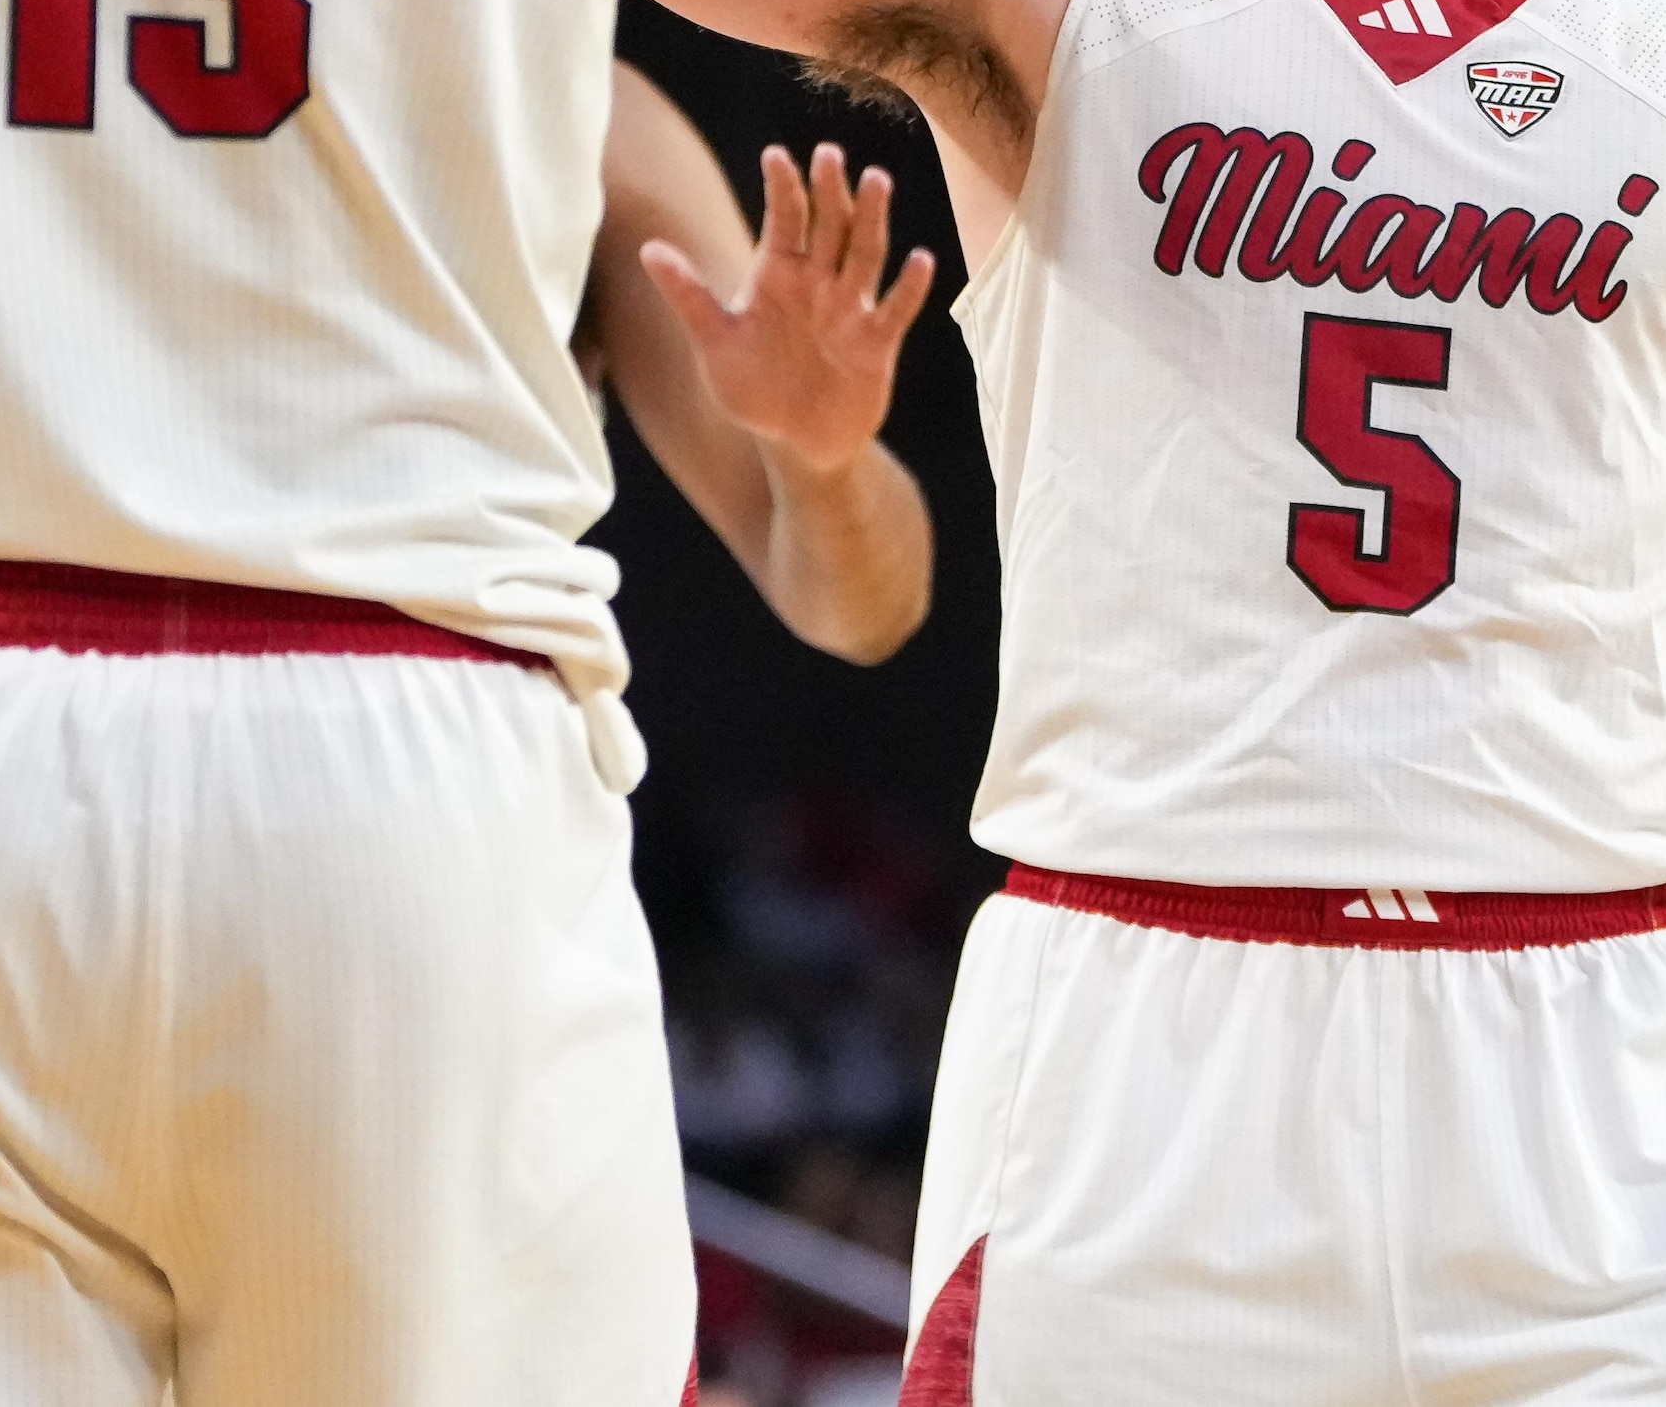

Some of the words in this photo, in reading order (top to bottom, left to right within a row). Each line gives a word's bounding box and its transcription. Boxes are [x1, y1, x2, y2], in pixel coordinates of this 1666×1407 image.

[1473, 81, 1556, 109] MAC
[1137, 121, 1660, 324] Miami
[1285, 310, 1462, 618] 5
